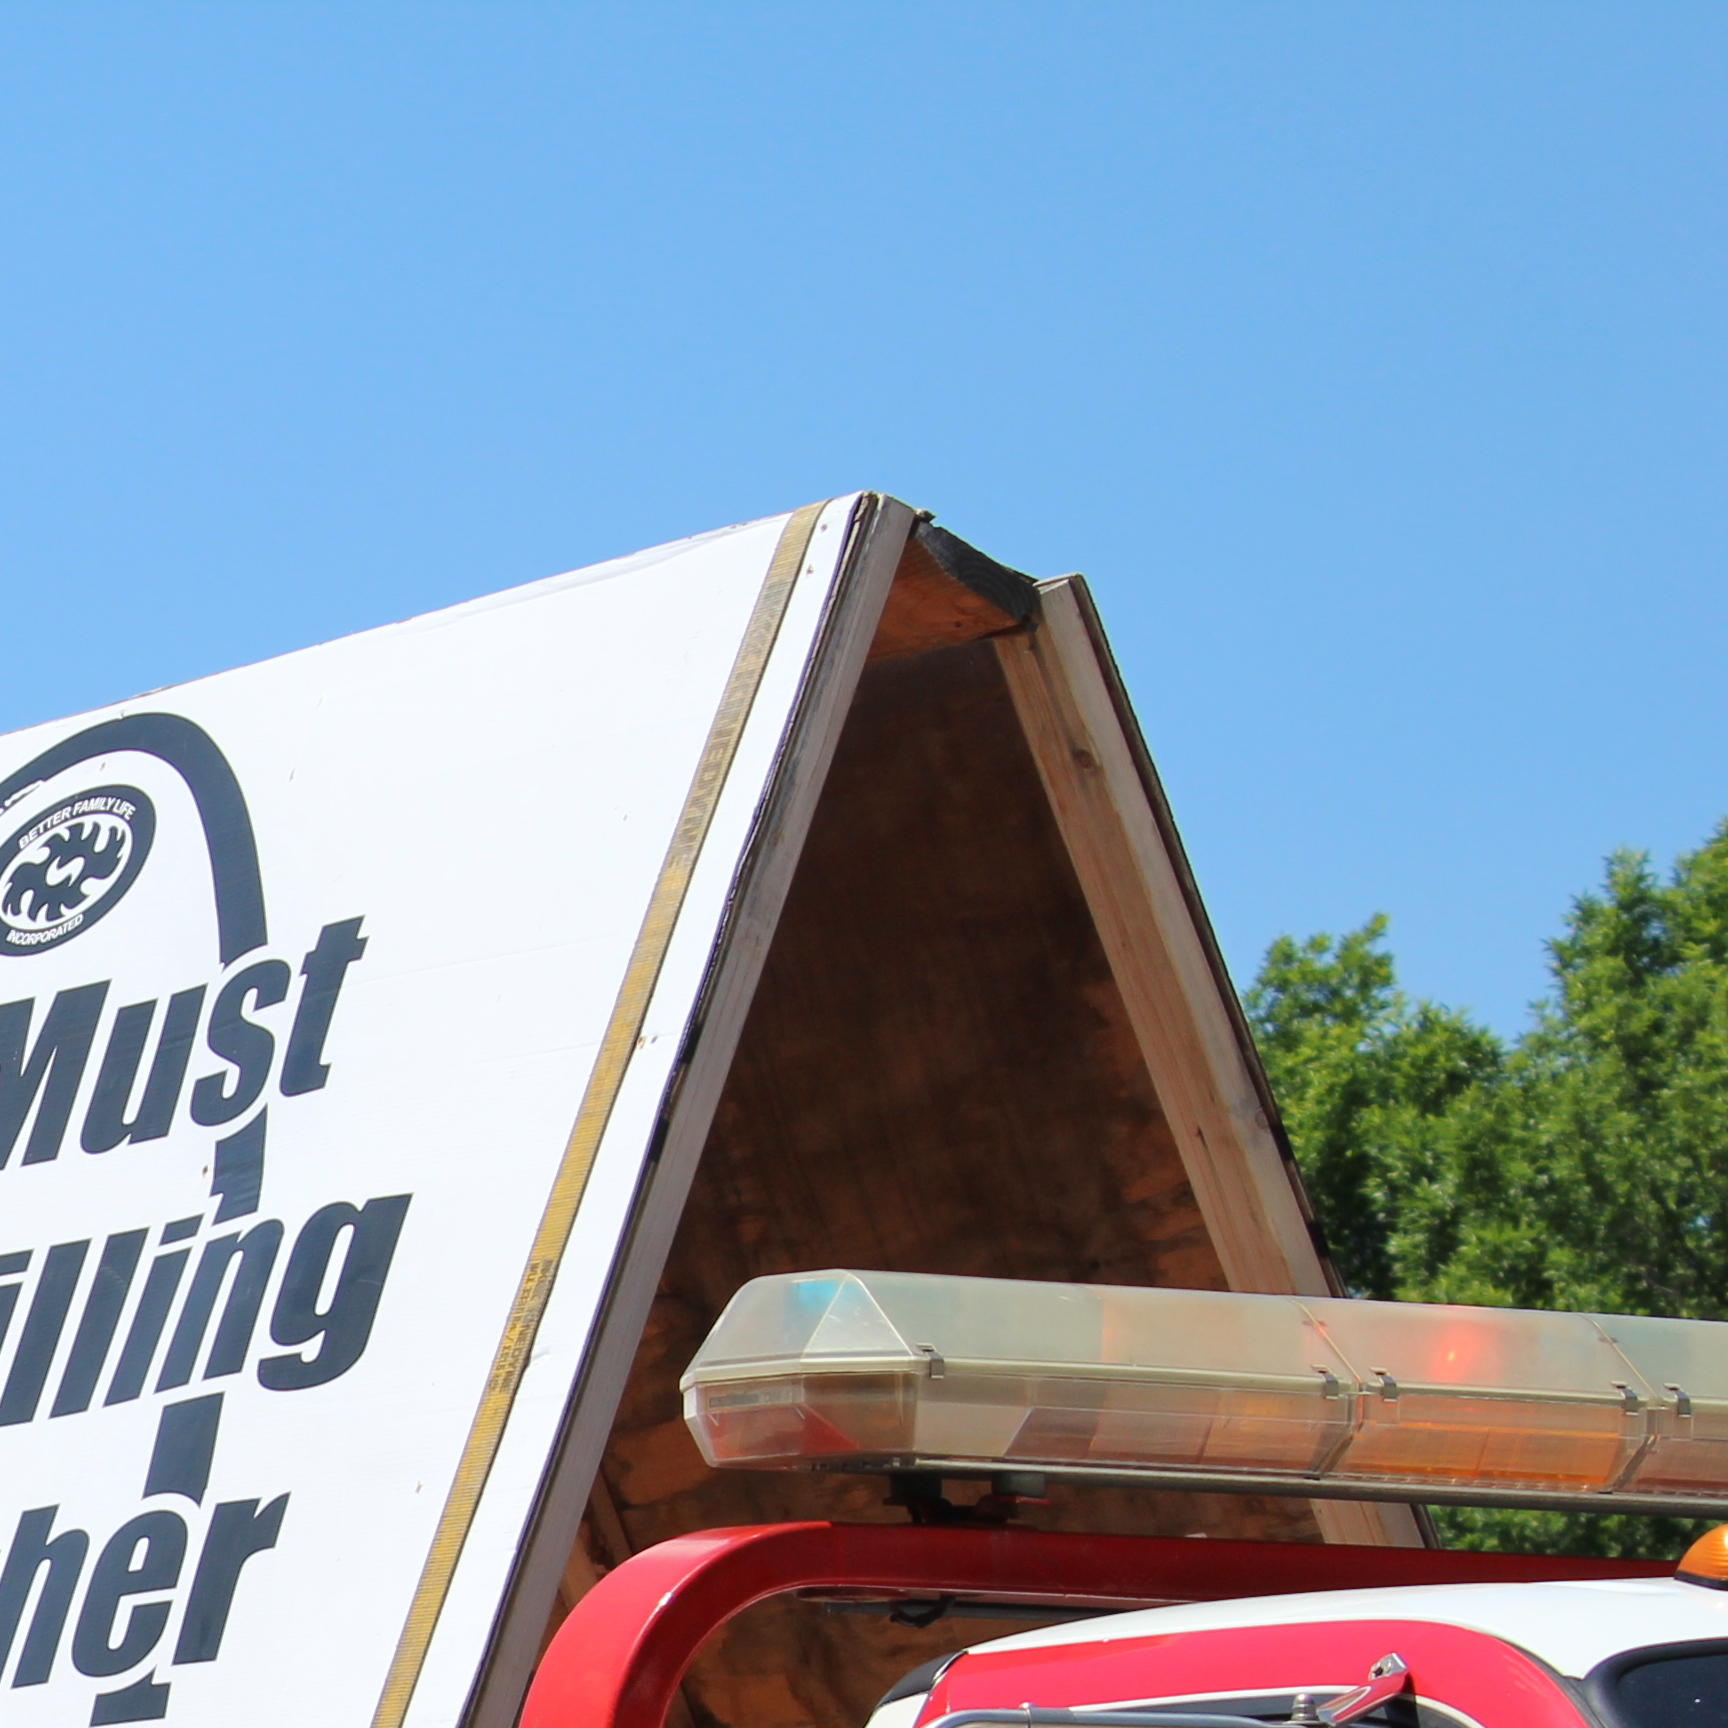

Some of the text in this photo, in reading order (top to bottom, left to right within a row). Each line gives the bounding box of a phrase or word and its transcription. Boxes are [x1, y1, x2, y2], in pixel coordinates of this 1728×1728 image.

[18, 796, 137, 849] BETTER FAMILY LIFE
[5, 913, 84, 946] INCORPORATED
